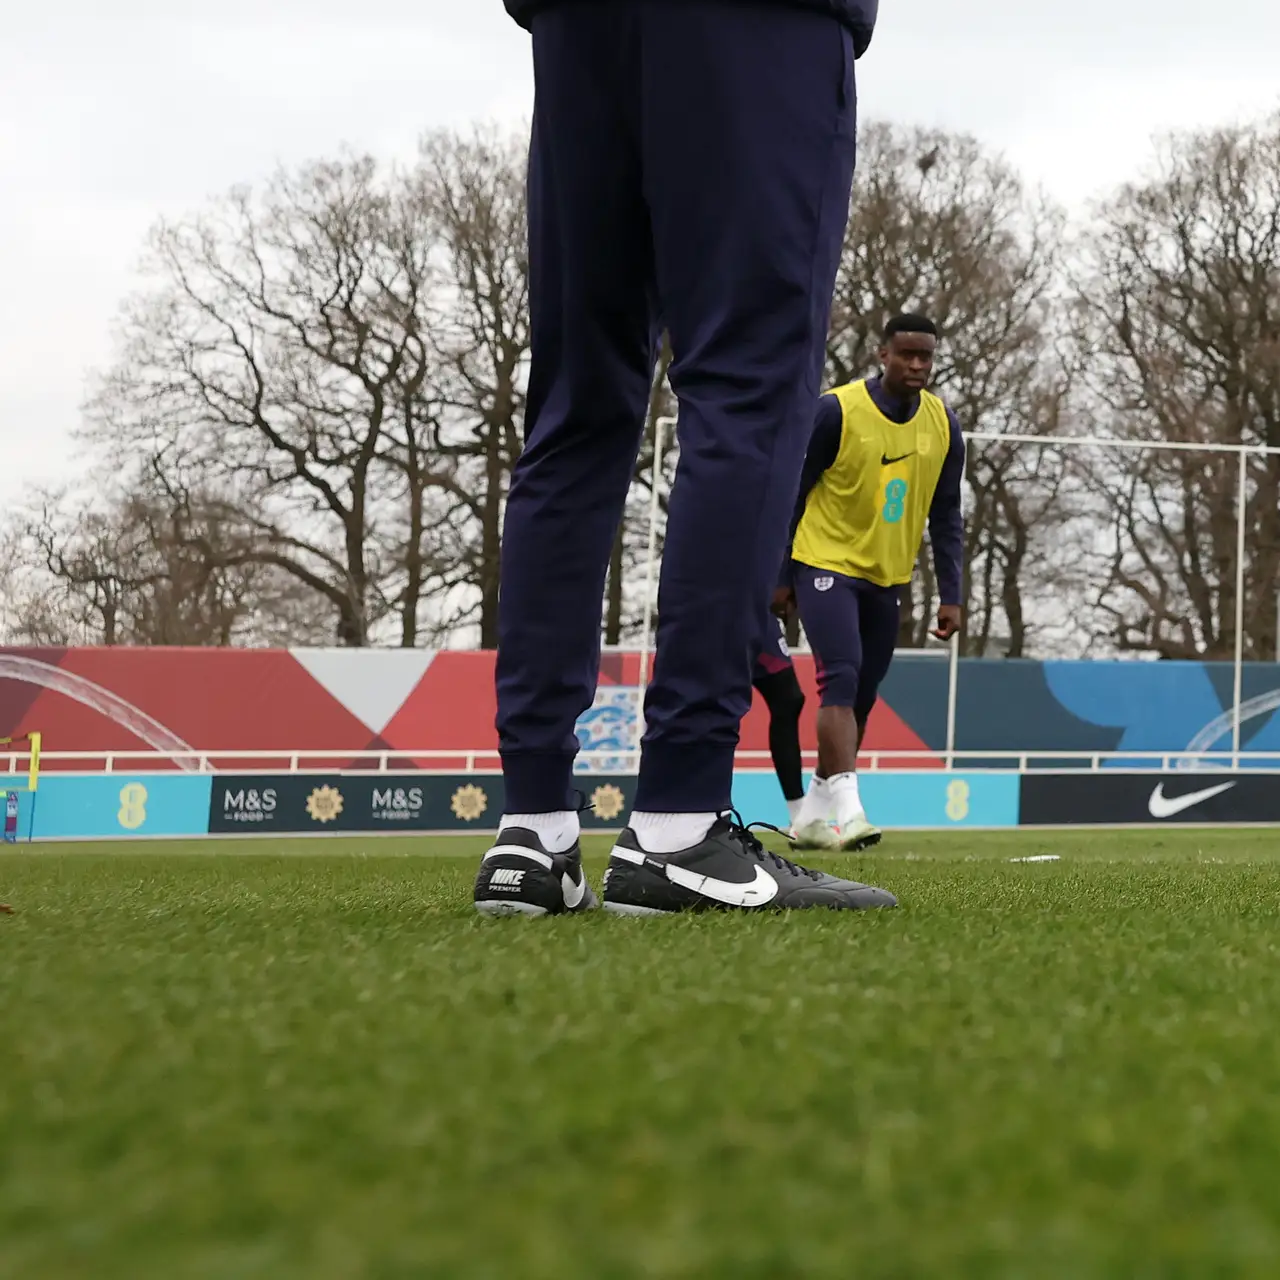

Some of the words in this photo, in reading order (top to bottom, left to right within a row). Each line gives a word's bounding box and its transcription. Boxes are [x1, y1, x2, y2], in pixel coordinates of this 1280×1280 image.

[224, 788, 277, 811] M&S
[371, 787, 423, 810] M&S
[490, 869, 526, 885] NIKE
